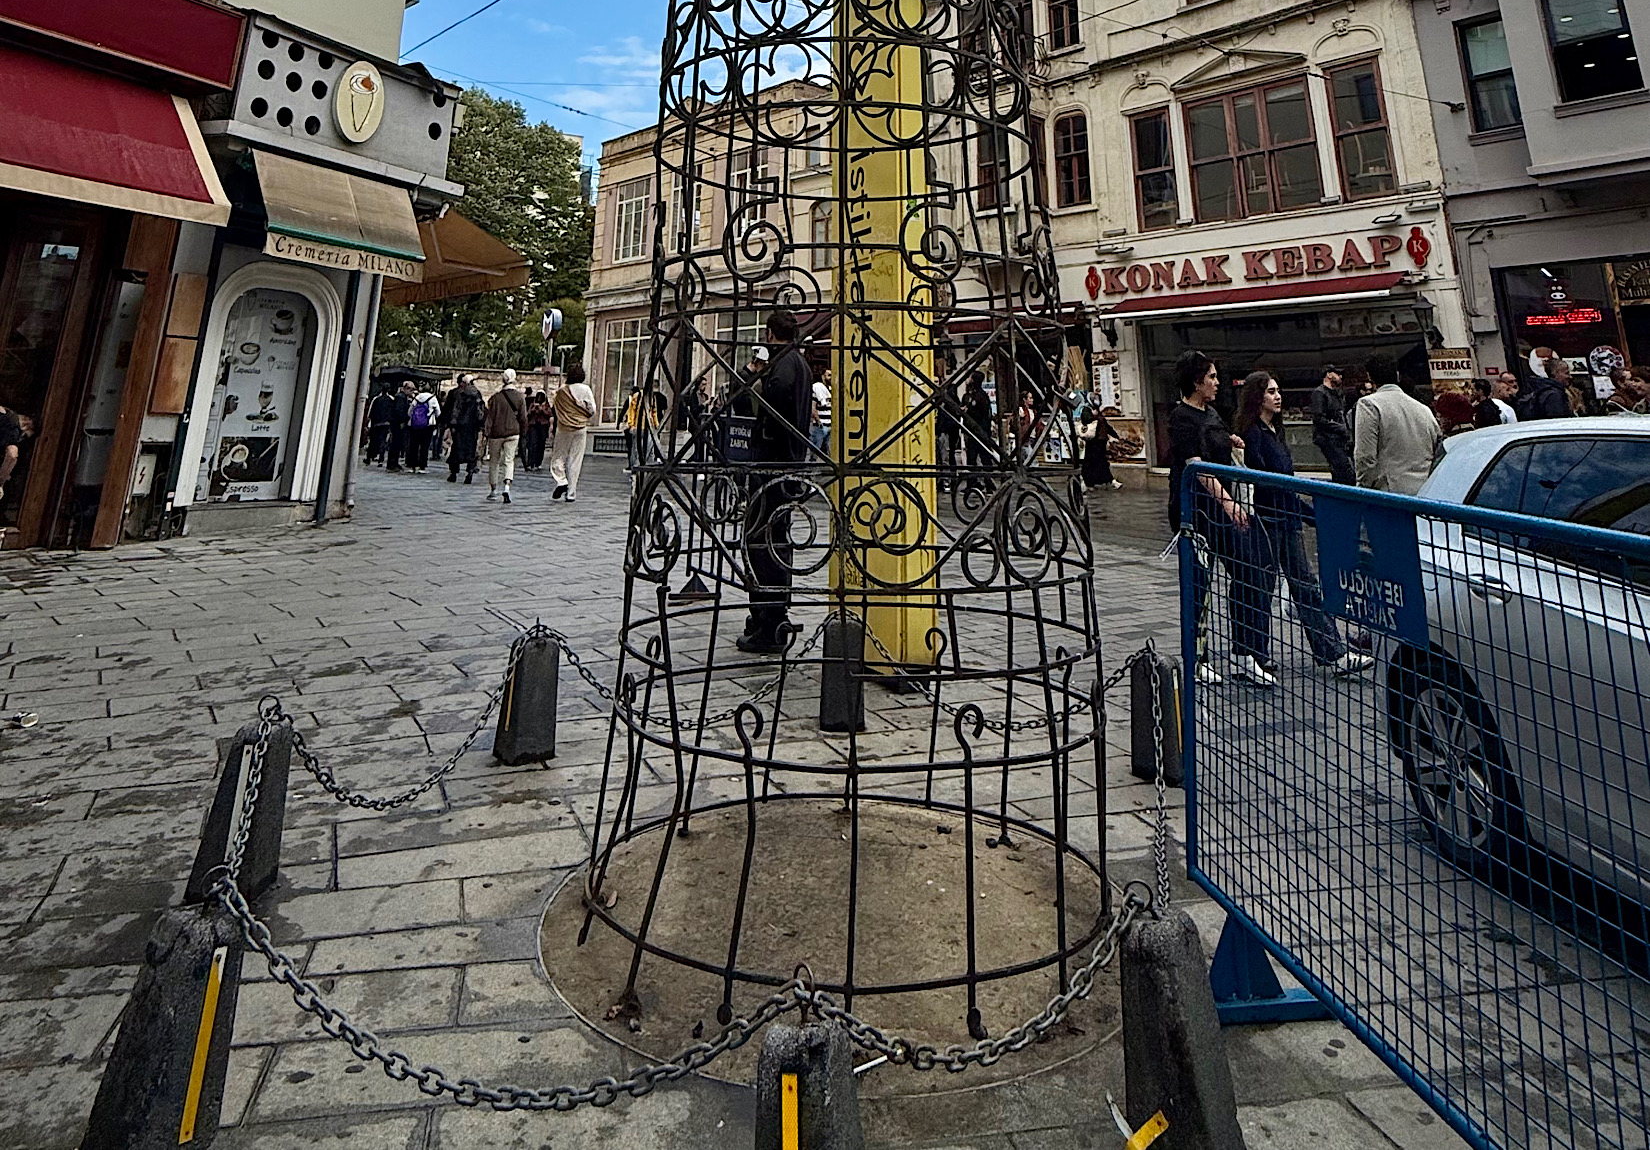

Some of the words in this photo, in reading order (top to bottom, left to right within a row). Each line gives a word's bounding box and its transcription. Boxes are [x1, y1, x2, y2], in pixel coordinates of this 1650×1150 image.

[275, 236, 350, 266] Cremeria
[357, 253, 415, 278] MILANO
[1101, 253, 1233, 295] KONAK
[1241, 234, 1402, 281] KEBAP
[1429, 360, 1472, 371] TERRACE
[251, 423, 270, 432] Latte
